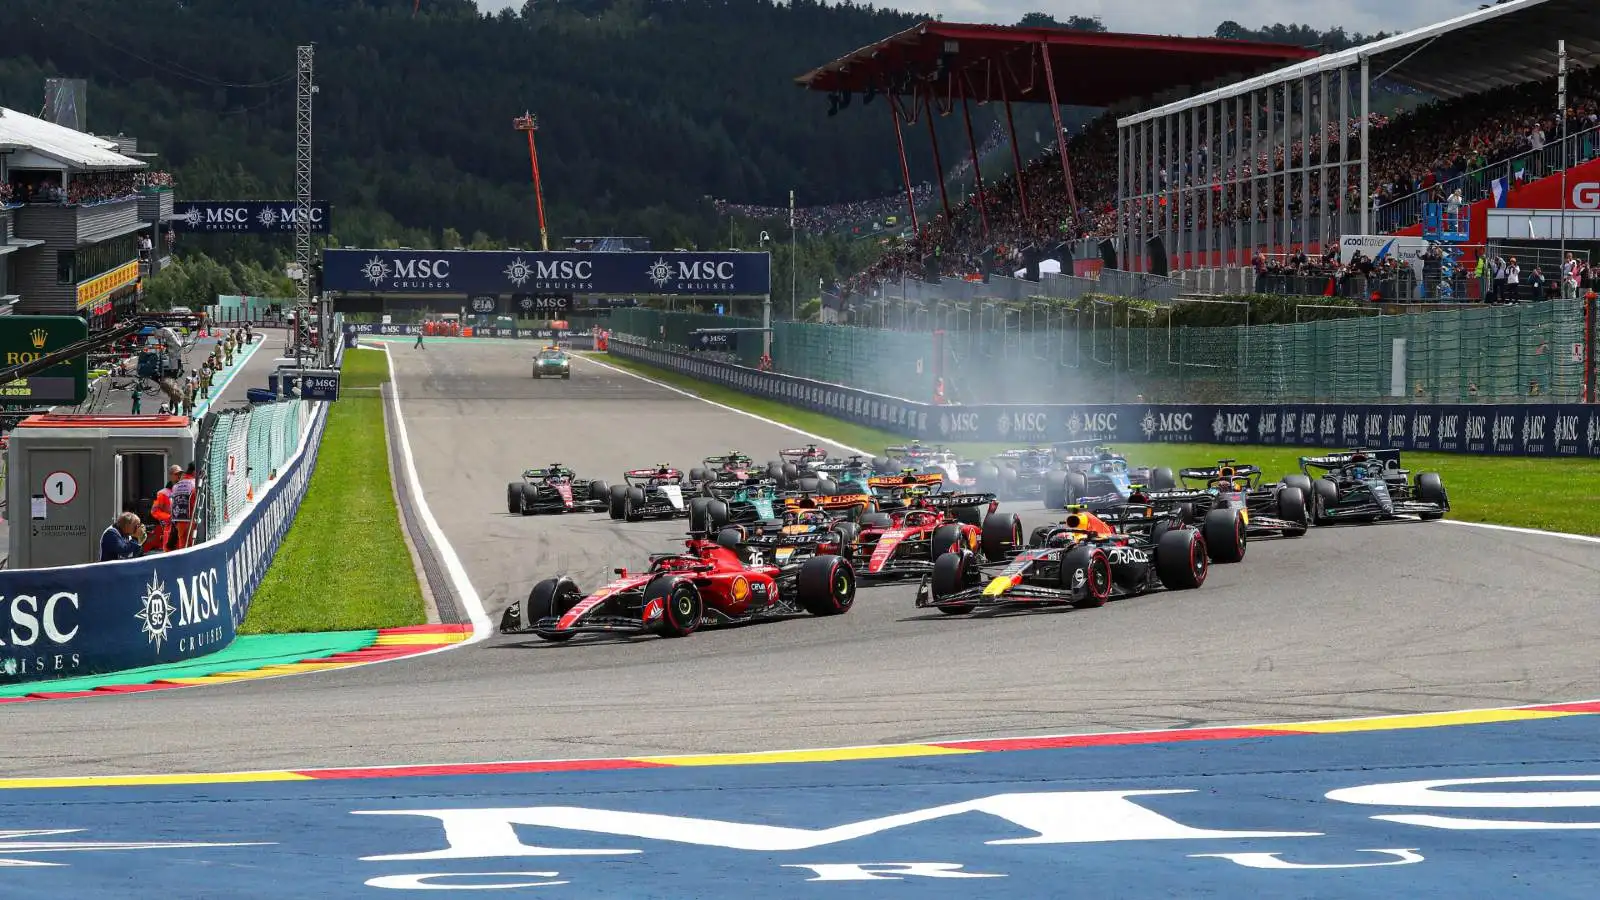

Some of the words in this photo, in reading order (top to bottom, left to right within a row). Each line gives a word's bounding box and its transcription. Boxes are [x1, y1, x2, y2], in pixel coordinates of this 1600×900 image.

[206, 208, 248, 222] MSC
[281, 208, 322, 222] MSC
[393, 259, 450, 278] MSC
[536, 260, 593, 279] MSC
[677, 261, 734, 280] MSC
[536, 298, 567, 307] MSC
[315, 379, 336, 387] MSC
[1014, 412, 1046, 431] MSC
[1084, 413, 1118, 431] MSC
[1160, 413, 1192, 431] MSC
[1227, 413, 1249, 433] MSC
[1530, 416, 1545, 440] MSC
[1561, 416, 1578, 440] MSC
[56, 481, 63, 495] 1
[749, 551, 764, 568] 16
[177, 568, 219, 626] MSC
[0, 592, 79, 646] SC
[180, 625, 222, 652] CRUISES
